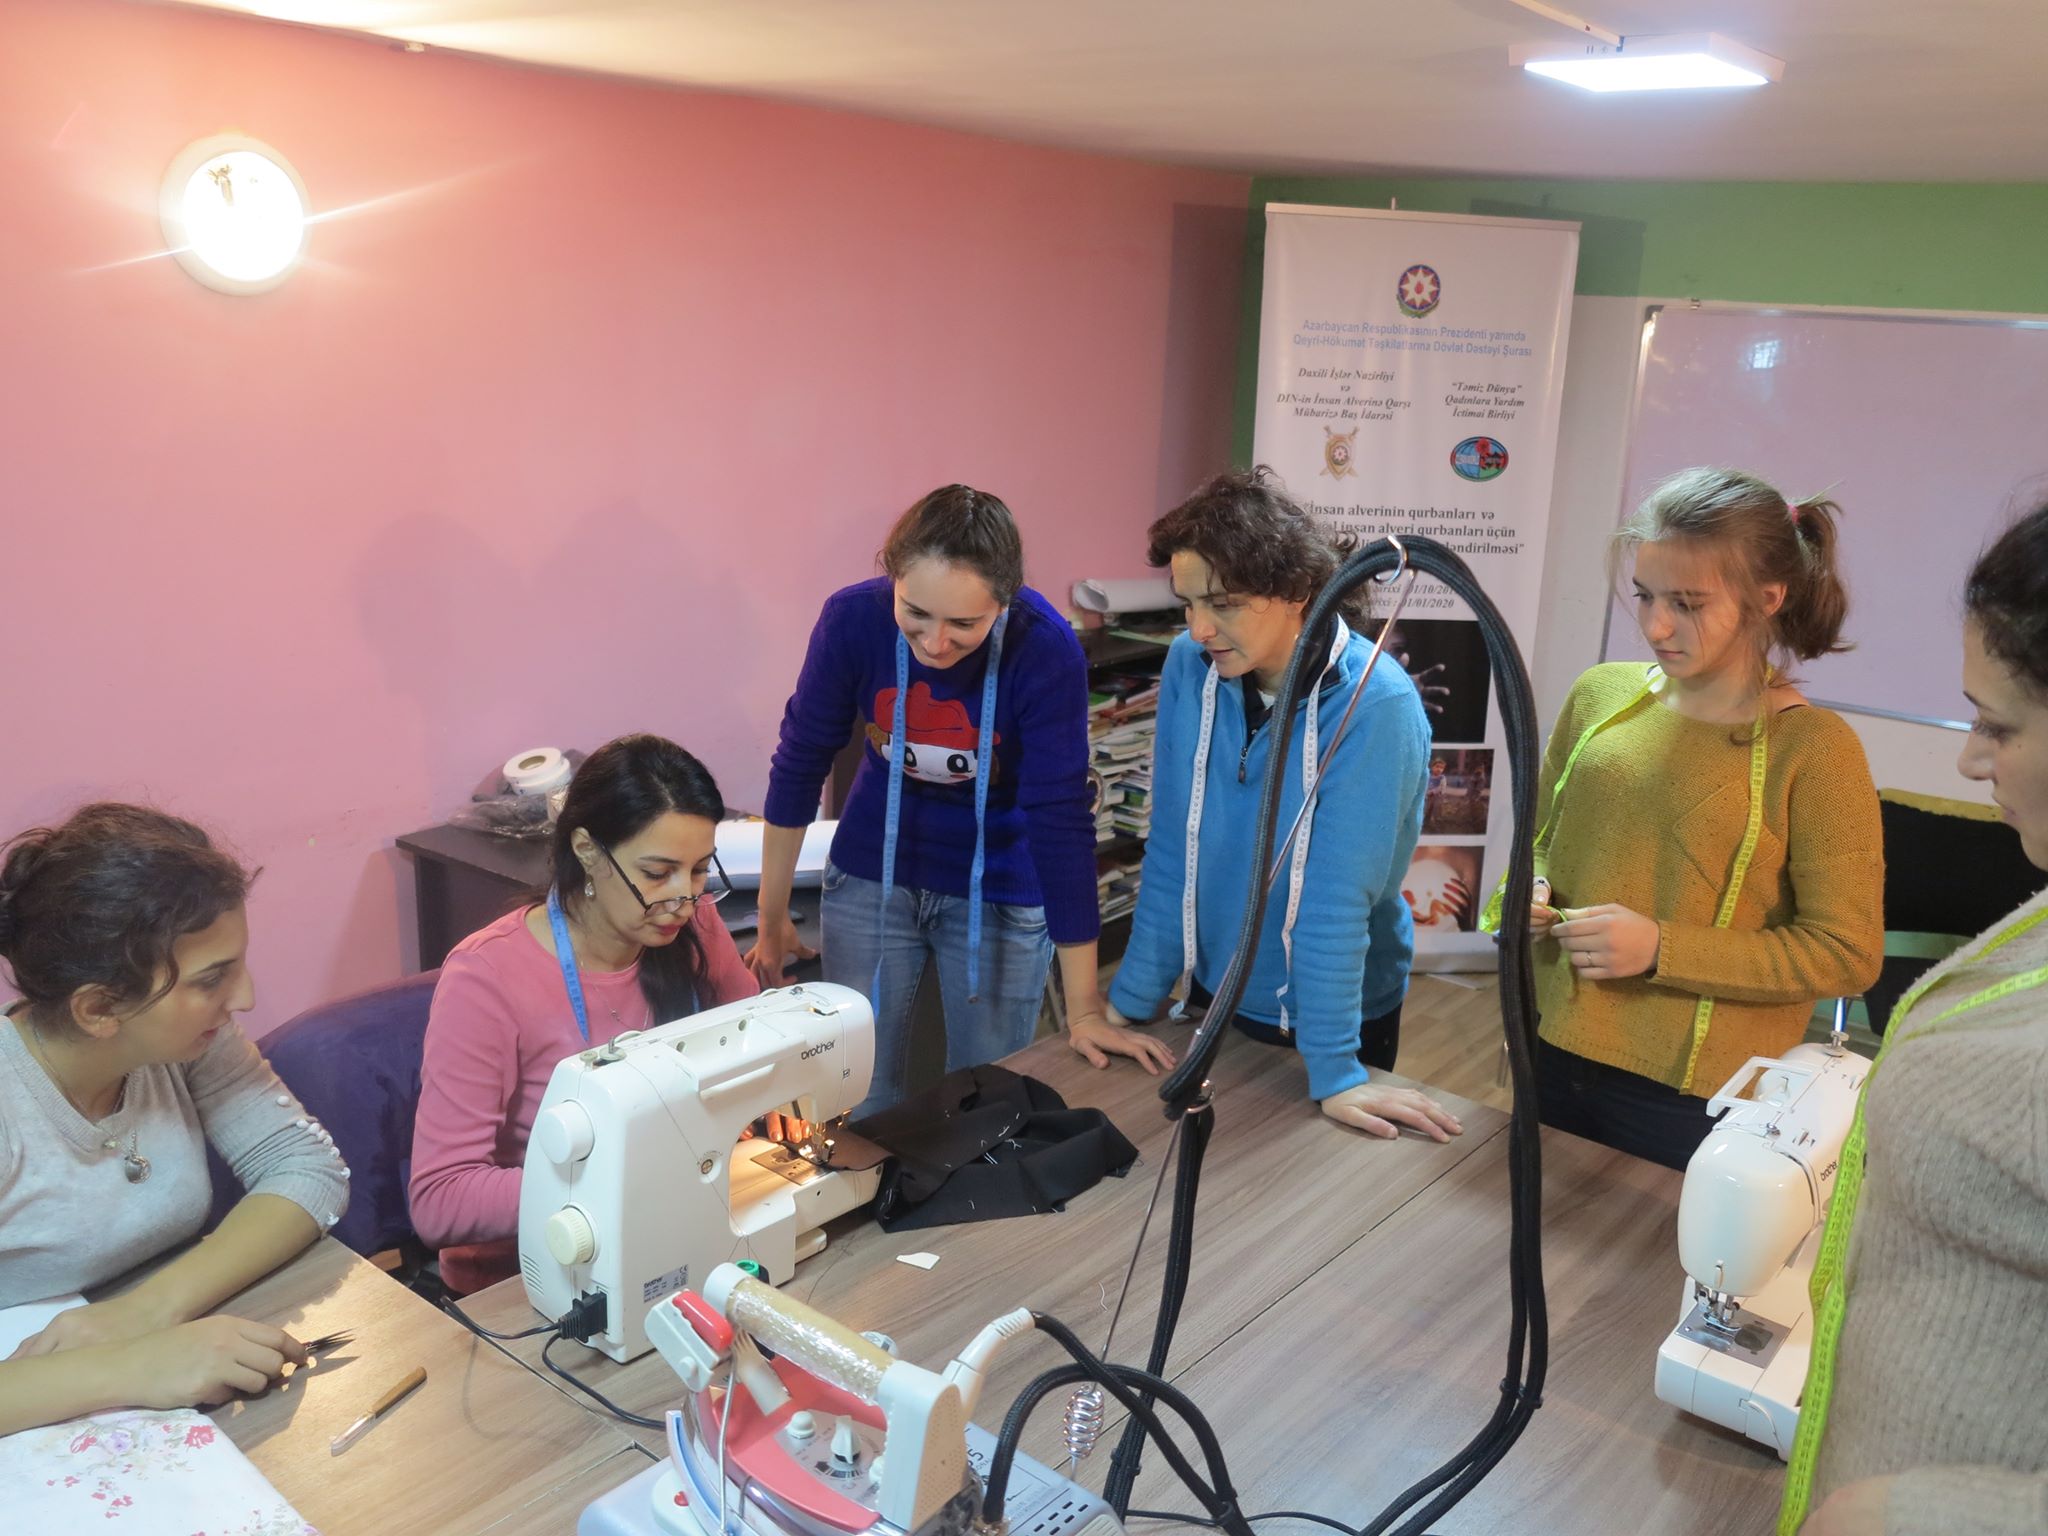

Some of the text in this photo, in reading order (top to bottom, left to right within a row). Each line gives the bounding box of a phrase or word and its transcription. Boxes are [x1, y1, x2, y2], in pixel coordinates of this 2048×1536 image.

[1440, 326, 1487, 339] Prezidenti
[1299, 368, 1327, 378] Daxili
[1348, 504, 1405, 518] alverinin
[1408, 507, 1476, 520] qurbanları
[1481, 511, 1495, 520] və
[1378, 522, 1414, 535] alveri
[1417, 524, 1484, 538] qurbanları
[1487, 526, 1515, 539] üçün
